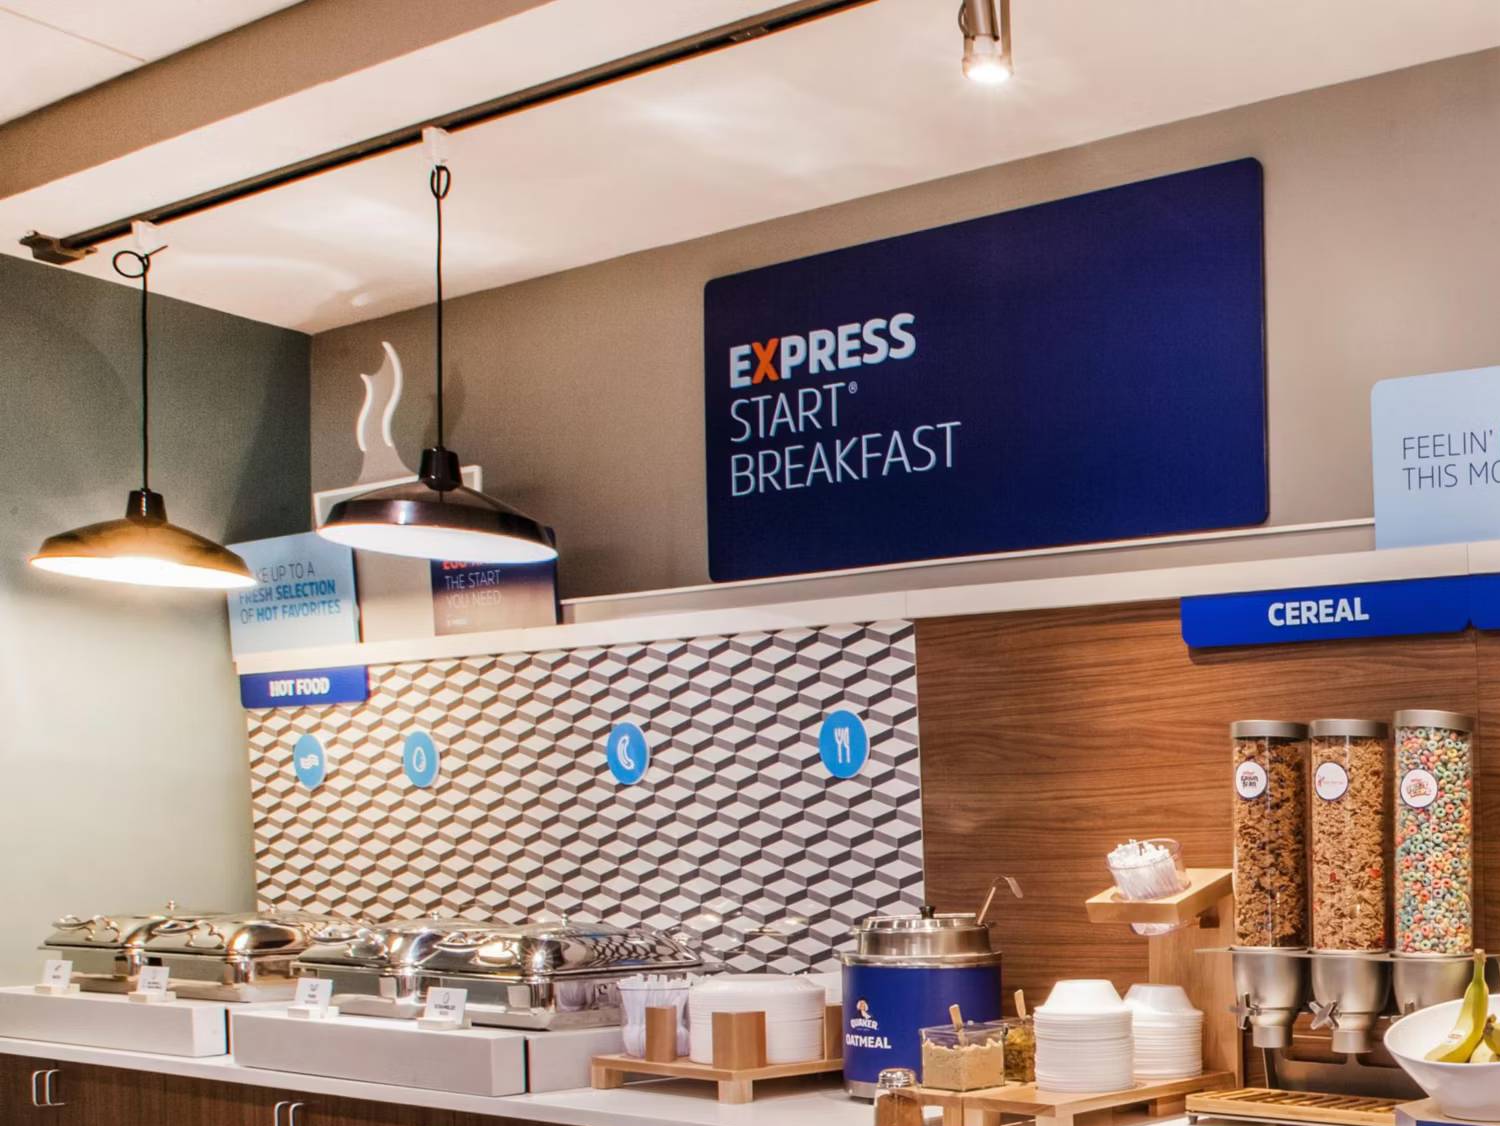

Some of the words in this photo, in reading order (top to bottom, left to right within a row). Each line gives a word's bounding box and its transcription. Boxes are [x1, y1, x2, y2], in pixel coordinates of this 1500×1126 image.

[729, 312, 917, 388] EXPRESS
[1402, 429, 1493, 460] FEELIN'
[731, 421, 962, 496] BREAKFAST
[1402, 463, 1458, 490] THIS
[271, 565, 286, 581] UP
[288, 562, 303, 579] TO
[308, 561, 315, 577] A
[444, 573, 465, 590] THE
[468, 569, 501, 588] START
[240, 586, 273, 606] FRESH
[275, 579, 336, 601] SELECTION
[446, 593, 469, 608] YOU
[472, 590, 502, 606] NEED
[240, 607, 254, 624] OF
[256, 606, 278, 622] HOT
[281, 599, 341, 618] FAVORITES
[1268, 597, 1370, 627] CEREAL
[269, 679, 294, 697] HOT
[296, 677, 330, 695] FOOD
[850, 1018, 878, 1030] QUAKER
[845, 1033, 892, 1049] OATMEAL
